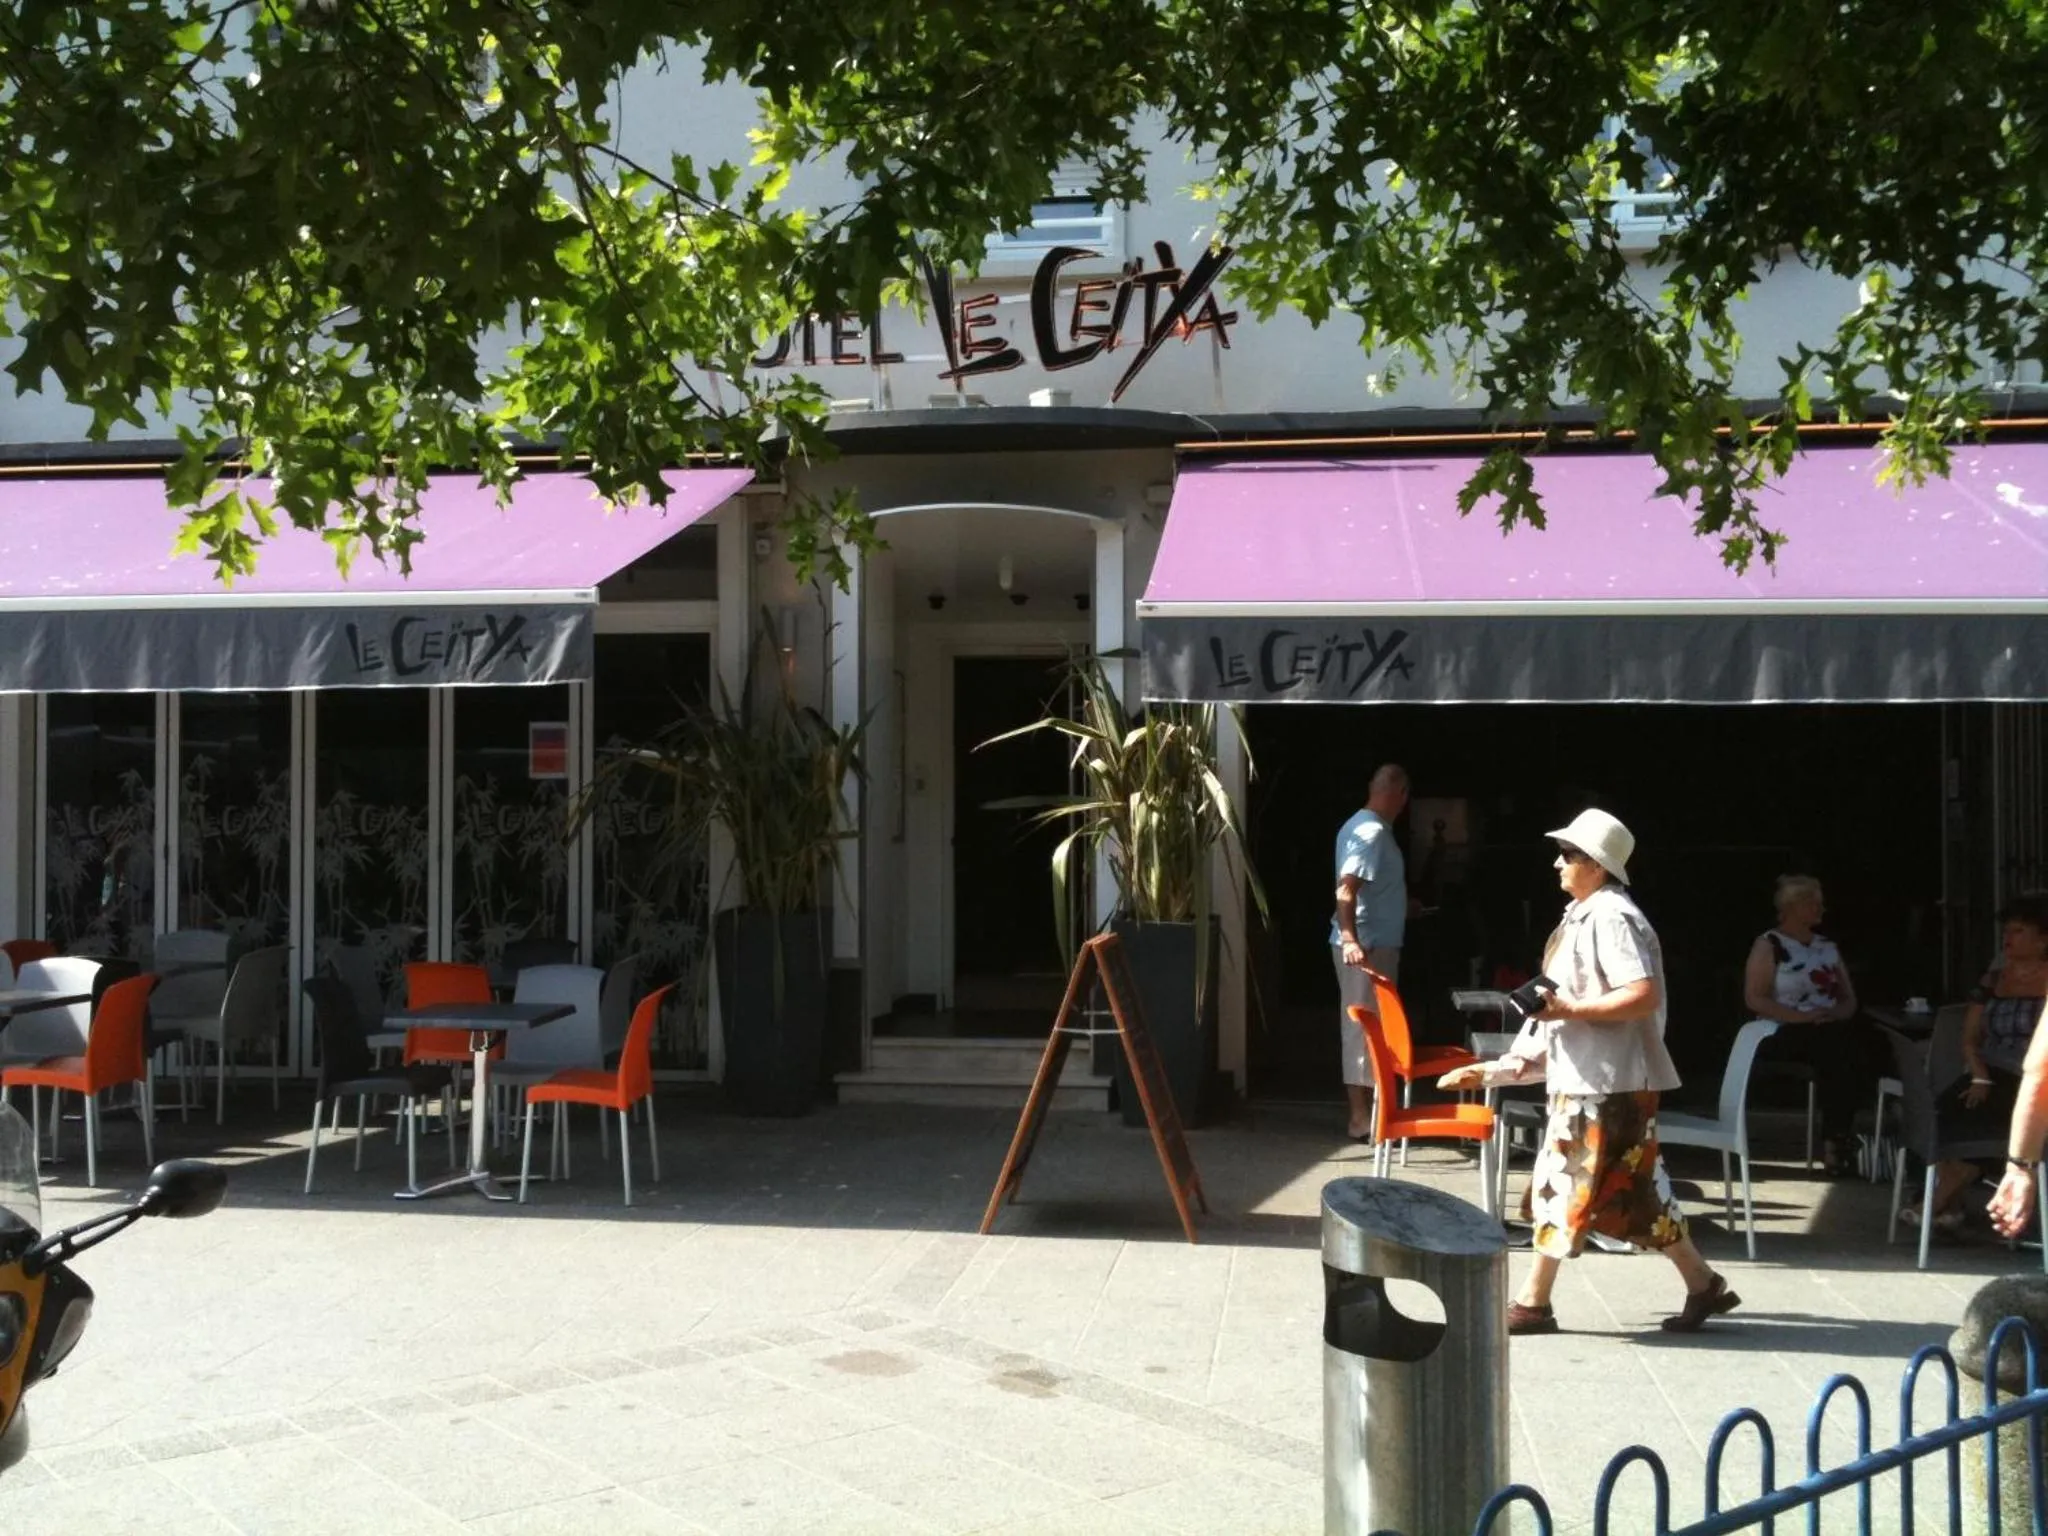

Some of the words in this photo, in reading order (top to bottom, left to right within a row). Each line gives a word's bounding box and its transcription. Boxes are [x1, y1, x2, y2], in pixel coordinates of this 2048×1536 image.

[911, 230, 1024, 392] LE
[345, 623, 385, 673] LE
[1209, 636, 1252, 688] LE
